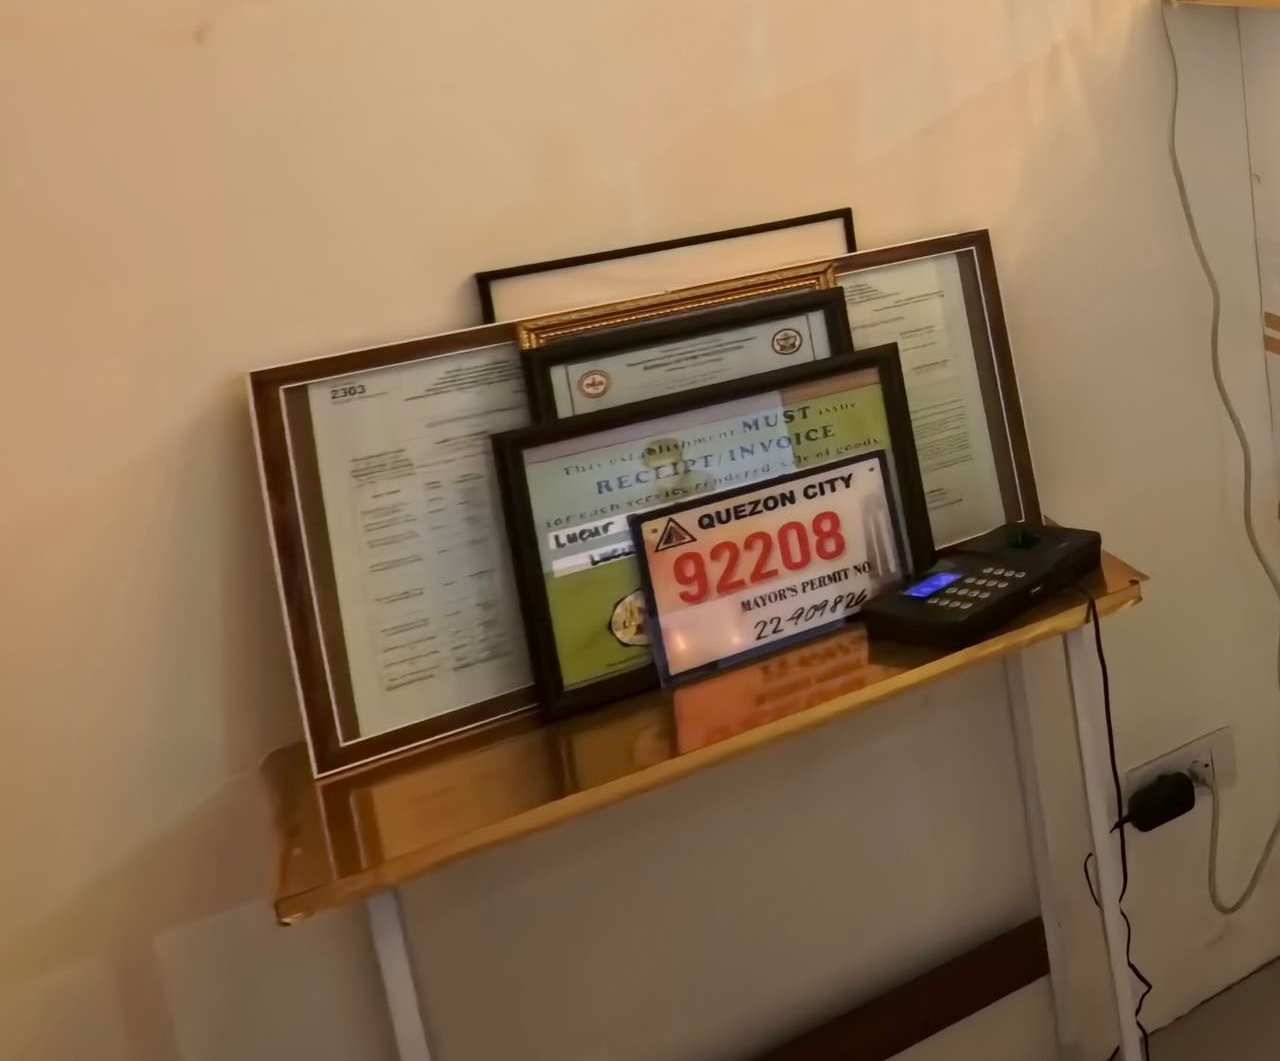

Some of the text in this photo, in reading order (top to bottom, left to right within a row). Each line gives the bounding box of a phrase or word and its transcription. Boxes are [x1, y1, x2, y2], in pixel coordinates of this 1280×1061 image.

[330, 384, 367, 400] 2303
[742, 405, 812, 434] MUST
[697, 473, 854, 530] QUEZON CITY
[673, 510, 846, 606] 92208
[741, 584, 799, 613] MAYOR'S
[801, 568, 849, 594] PERMIT
